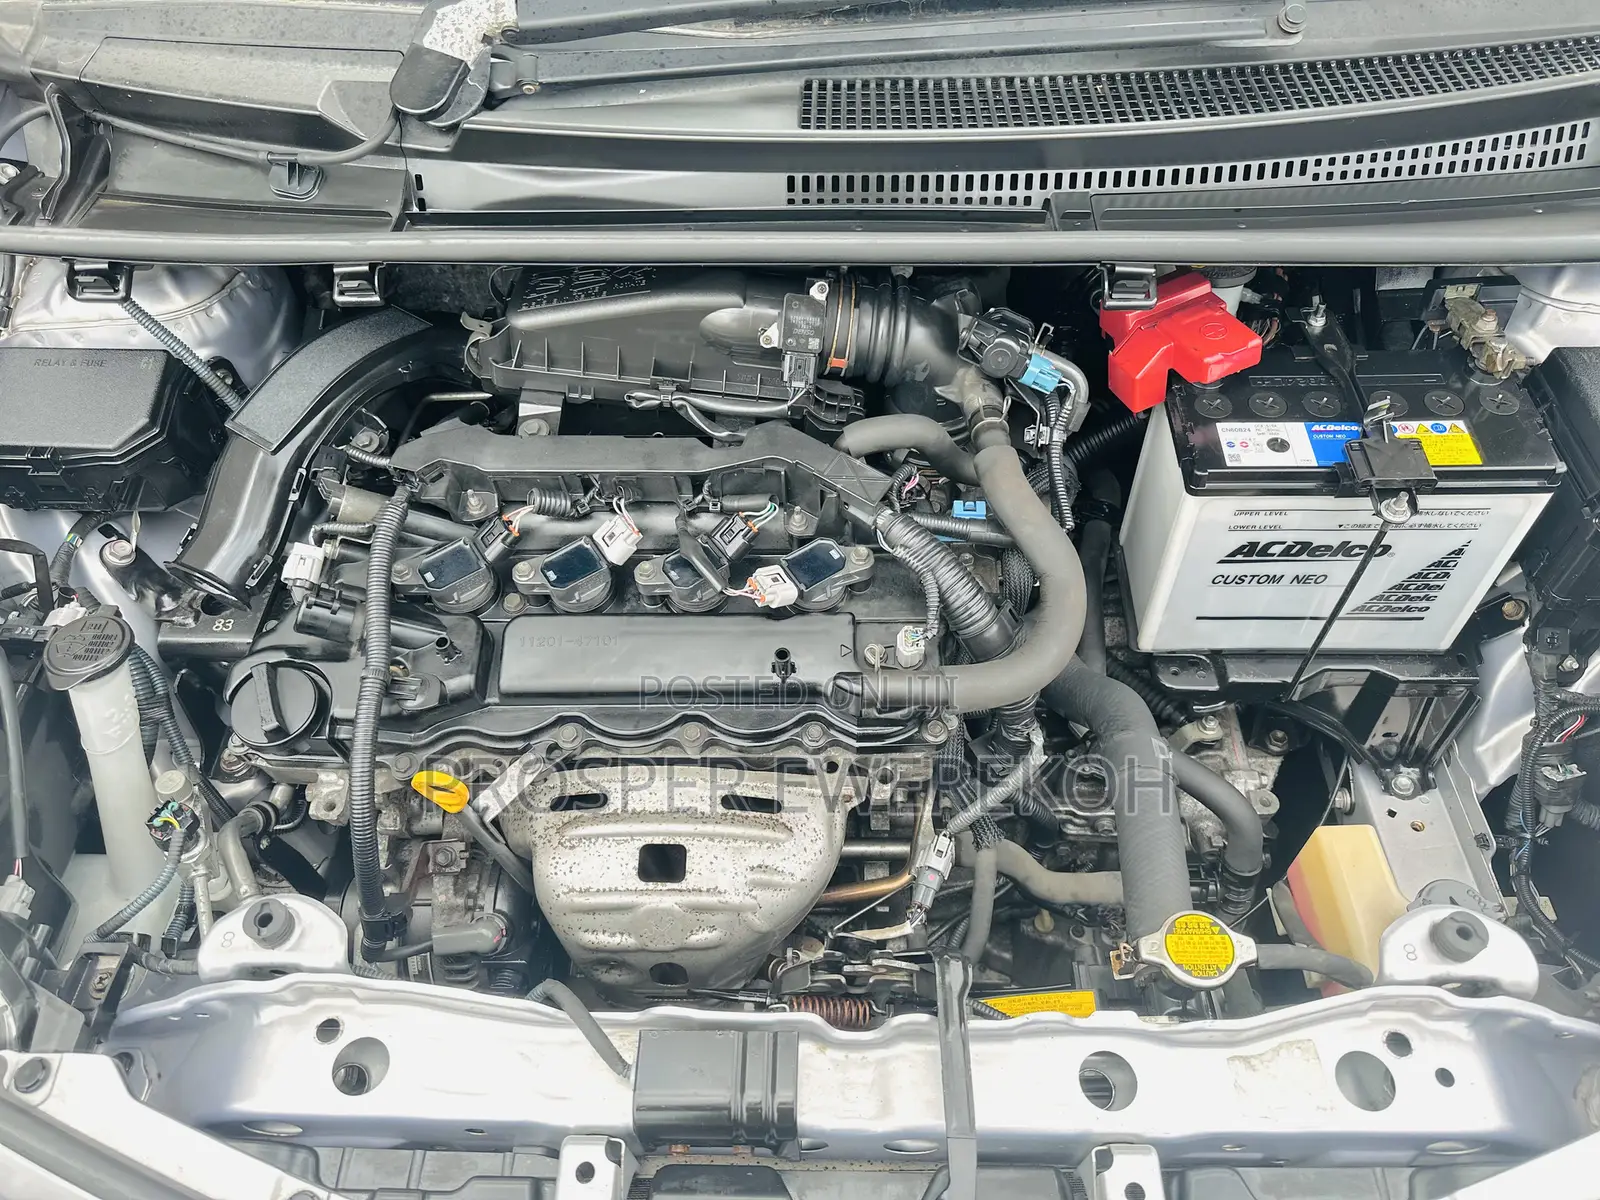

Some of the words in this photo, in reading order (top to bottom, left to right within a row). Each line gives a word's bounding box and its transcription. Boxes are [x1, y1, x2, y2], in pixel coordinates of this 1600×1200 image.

[34, 359, 68, 367] RELAY
[70, 359, 78, 367] &
[80, 359, 107, 367] FUSE
[1224, 541, 1392, 558] ACDelco
[1446, 548, 1465, 556] A
[1426, 560, 1459, 568] AC
[1211, 574, 1285, 584] CUSTOM
[1289, 574, 1328, 584] NEO
[1406, 572, 1451, 580] ACD
[1350, 604, 1430, 613] ACDelco
[212, 618, 234, 631] 83
[520, 634, 618, 647] 11201-47101
